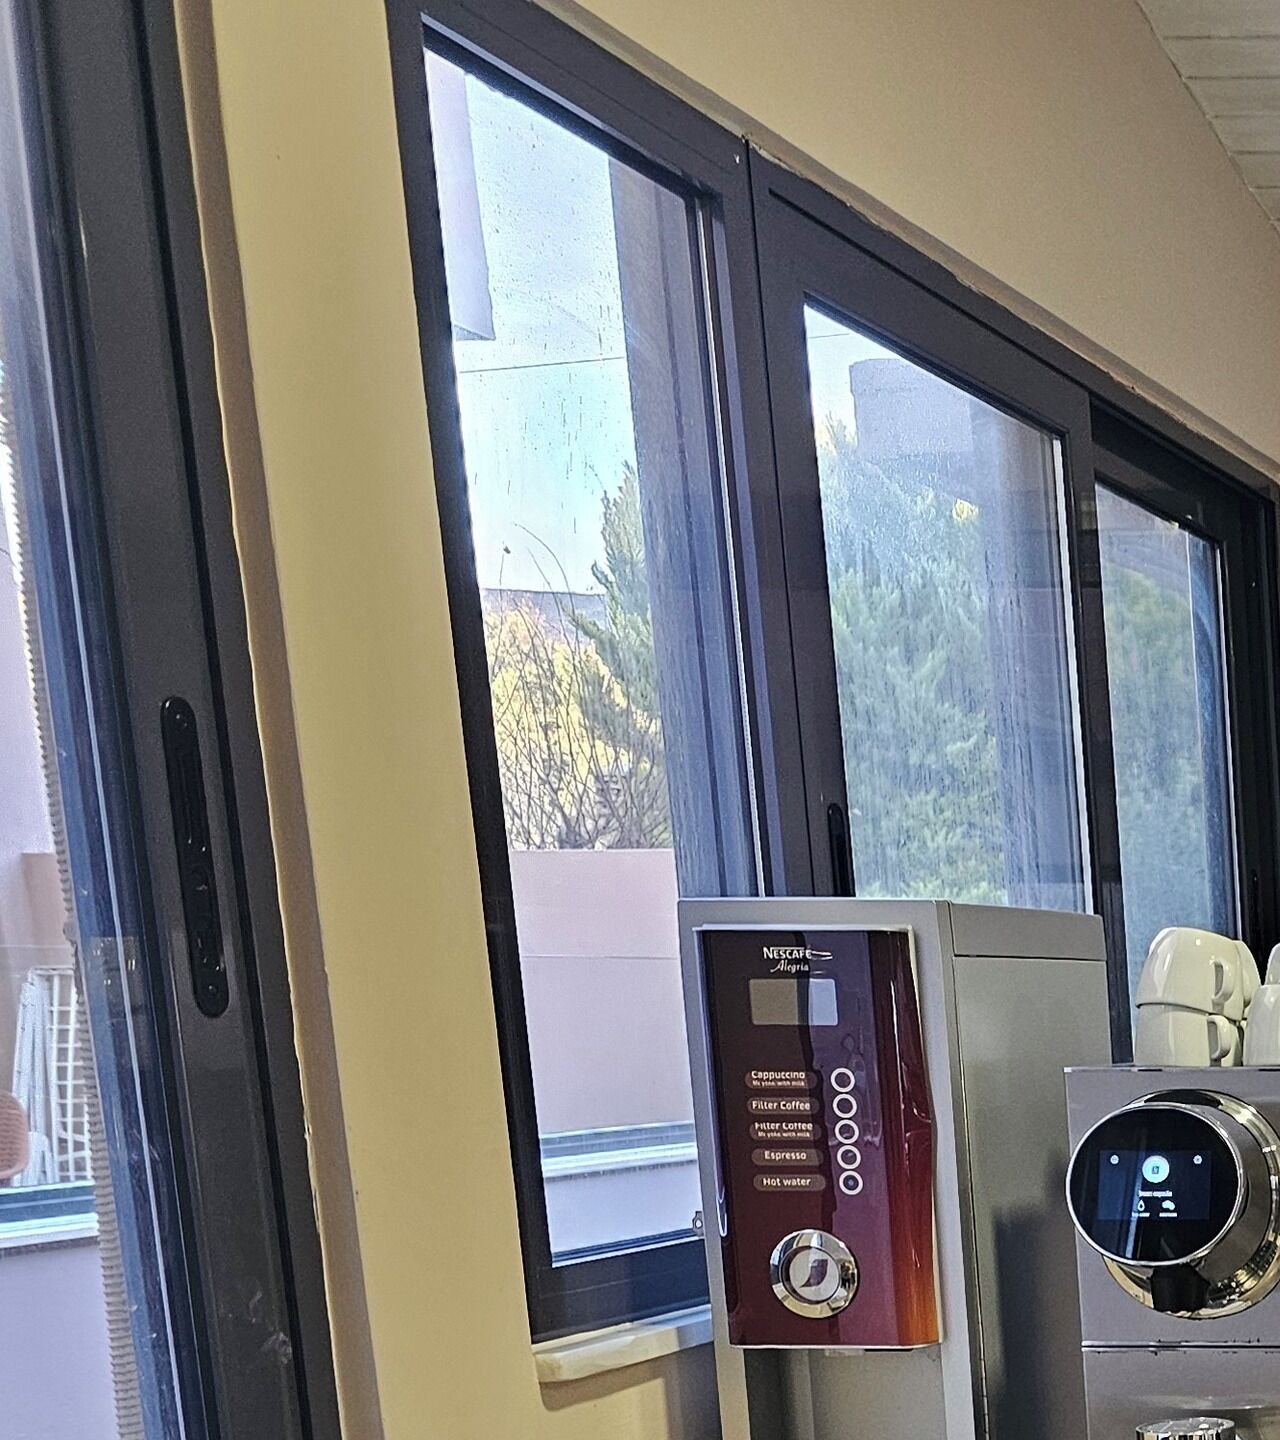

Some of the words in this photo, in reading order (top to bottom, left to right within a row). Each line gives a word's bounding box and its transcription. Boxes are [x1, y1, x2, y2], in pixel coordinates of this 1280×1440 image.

[770, 960, 809, 974] Alegria
[751, 1070, 805, 1080] Cappuccino
[752, 1101, 777, 1110] Filter
[780, 1101, 811, 1110] Coffee
[755, 1122, 780, 1130] Filter
[782, 1122, 813, 1130] Coffee
[764, 1151, 807, 1160] Espresso
[763, 1178, 780, 1186] Hot
